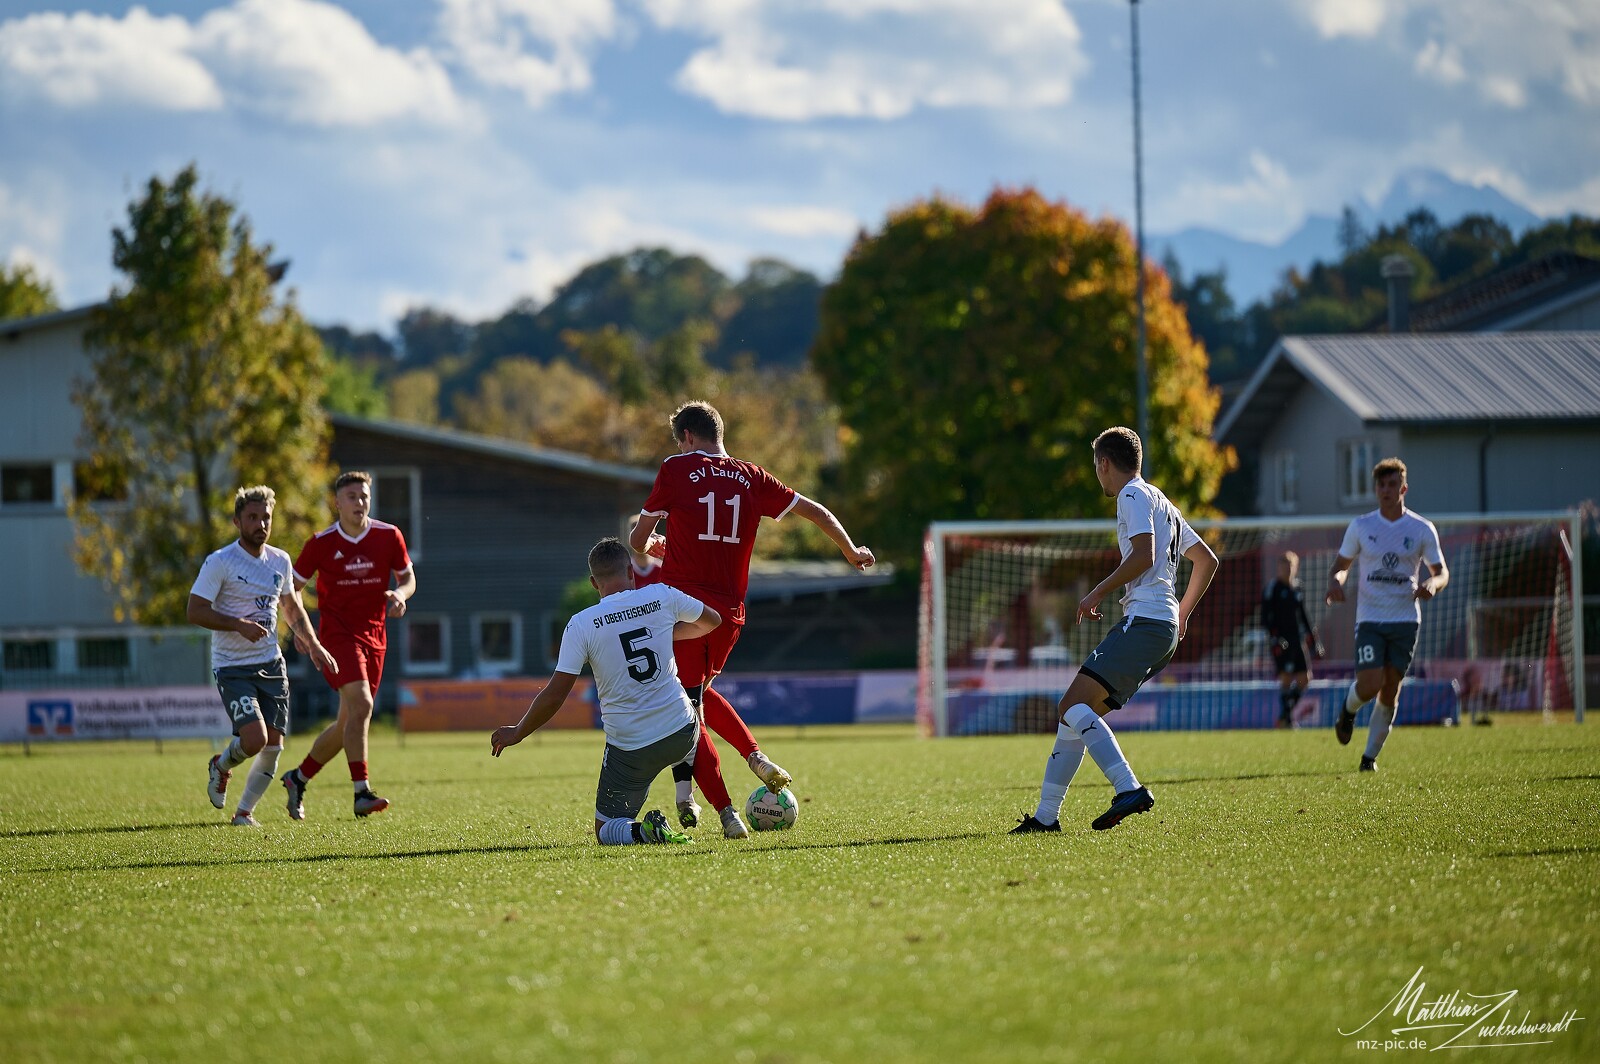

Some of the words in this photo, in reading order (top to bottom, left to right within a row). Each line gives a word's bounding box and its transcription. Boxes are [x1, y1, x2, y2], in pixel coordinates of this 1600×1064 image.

[689, 467, 706, 482] SV
[710, 466, 751, 489] Laufen
[698, 491, 741, 544] 11
[593, 617, 604, 629] SV
[604, 600, 661, 625] OBERTEISENDORF
[618, 627, 661, 685] 5
[1358, 645, 1374, 664] 18
[230, 695, 255, 721] 28
[753, 806, 783, 817] DERBYSTAR
